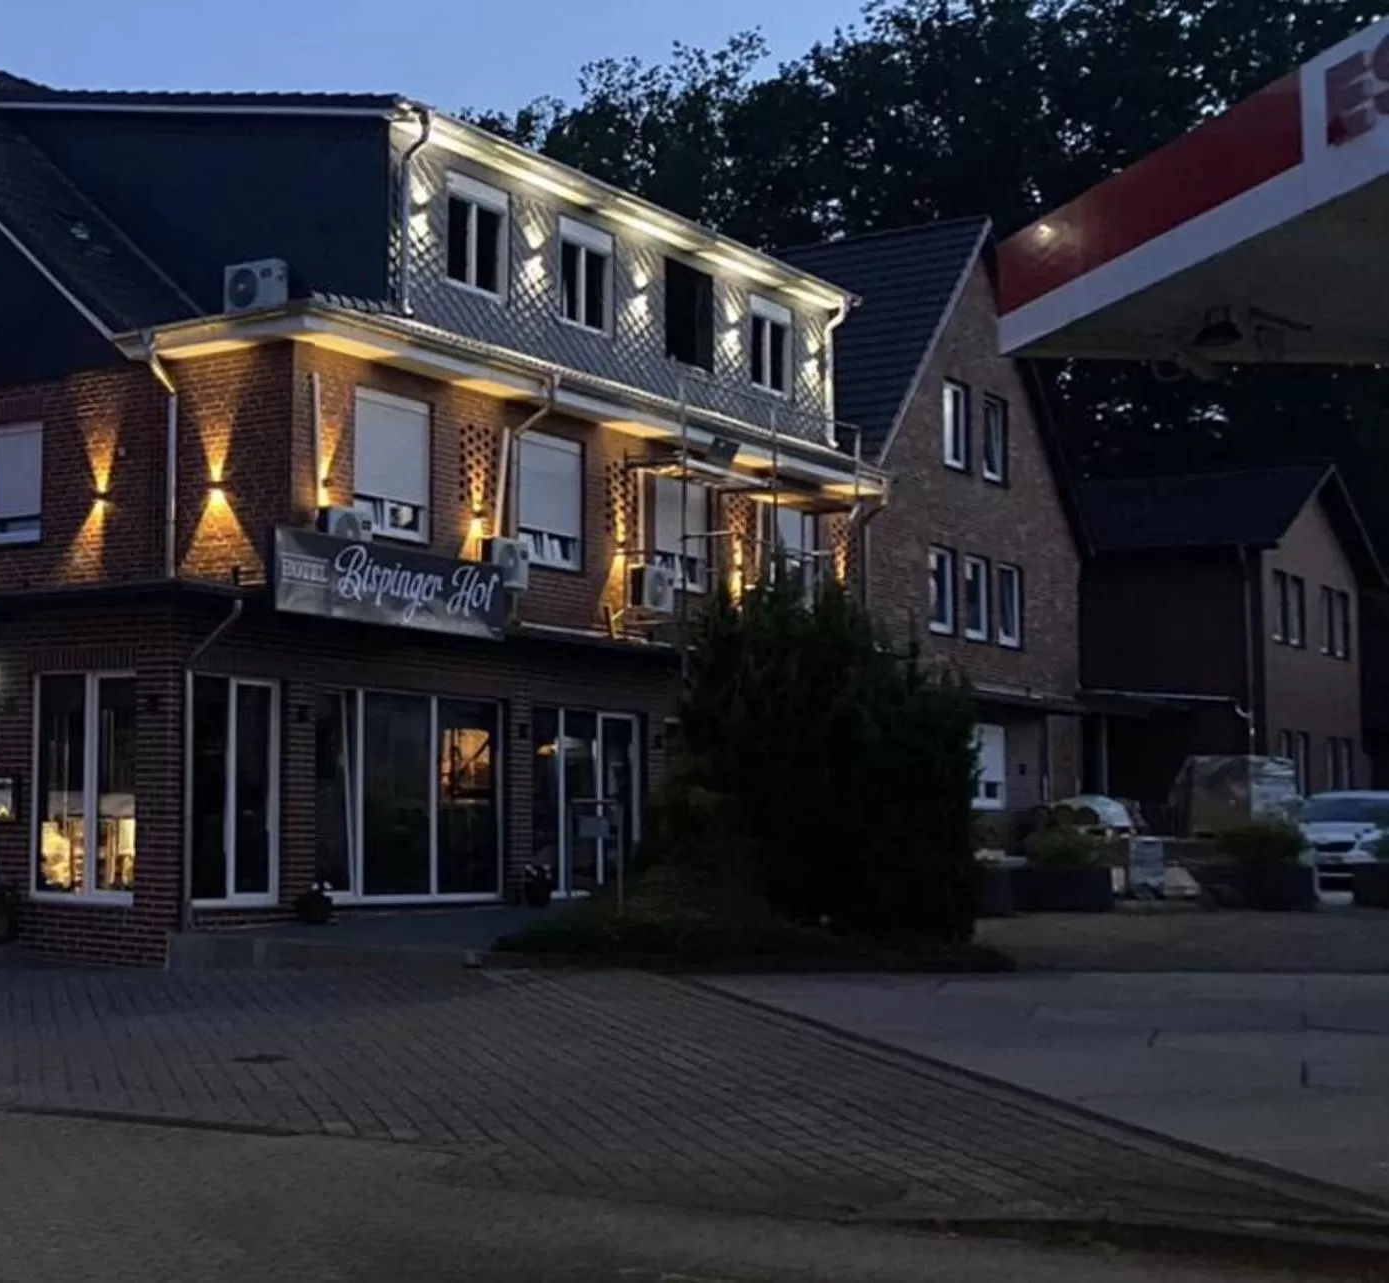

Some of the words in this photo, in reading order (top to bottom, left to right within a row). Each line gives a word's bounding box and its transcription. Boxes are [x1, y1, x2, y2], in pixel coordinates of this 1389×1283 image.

[280, 556, 329, 583] HOTEL
[334, 544, 444, 623] Bispinger
[446, 564, 500, 617] Hof
